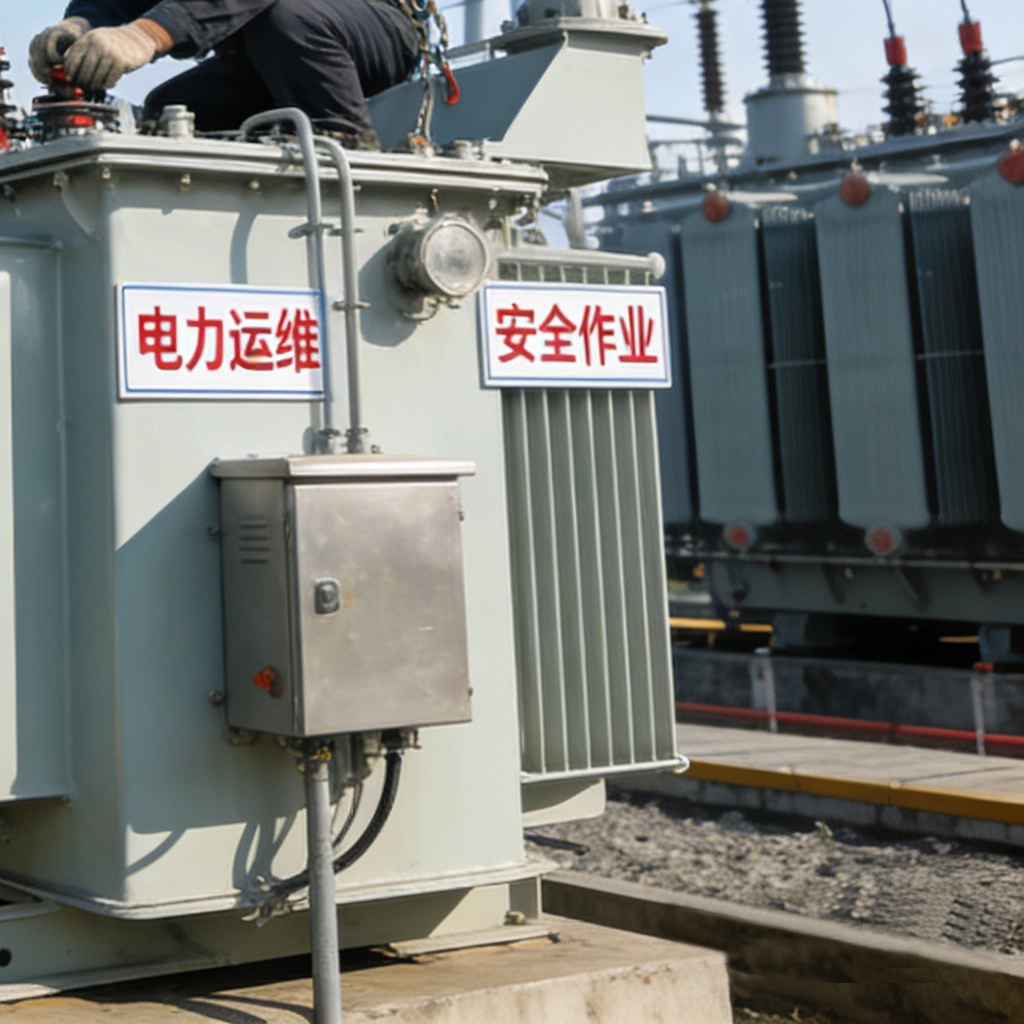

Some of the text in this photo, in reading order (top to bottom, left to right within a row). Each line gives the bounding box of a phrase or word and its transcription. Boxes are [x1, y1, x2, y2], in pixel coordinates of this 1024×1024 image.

[138, 306, 320, 372] 电力运维
[496, 303, 658, 366] 安全作业
